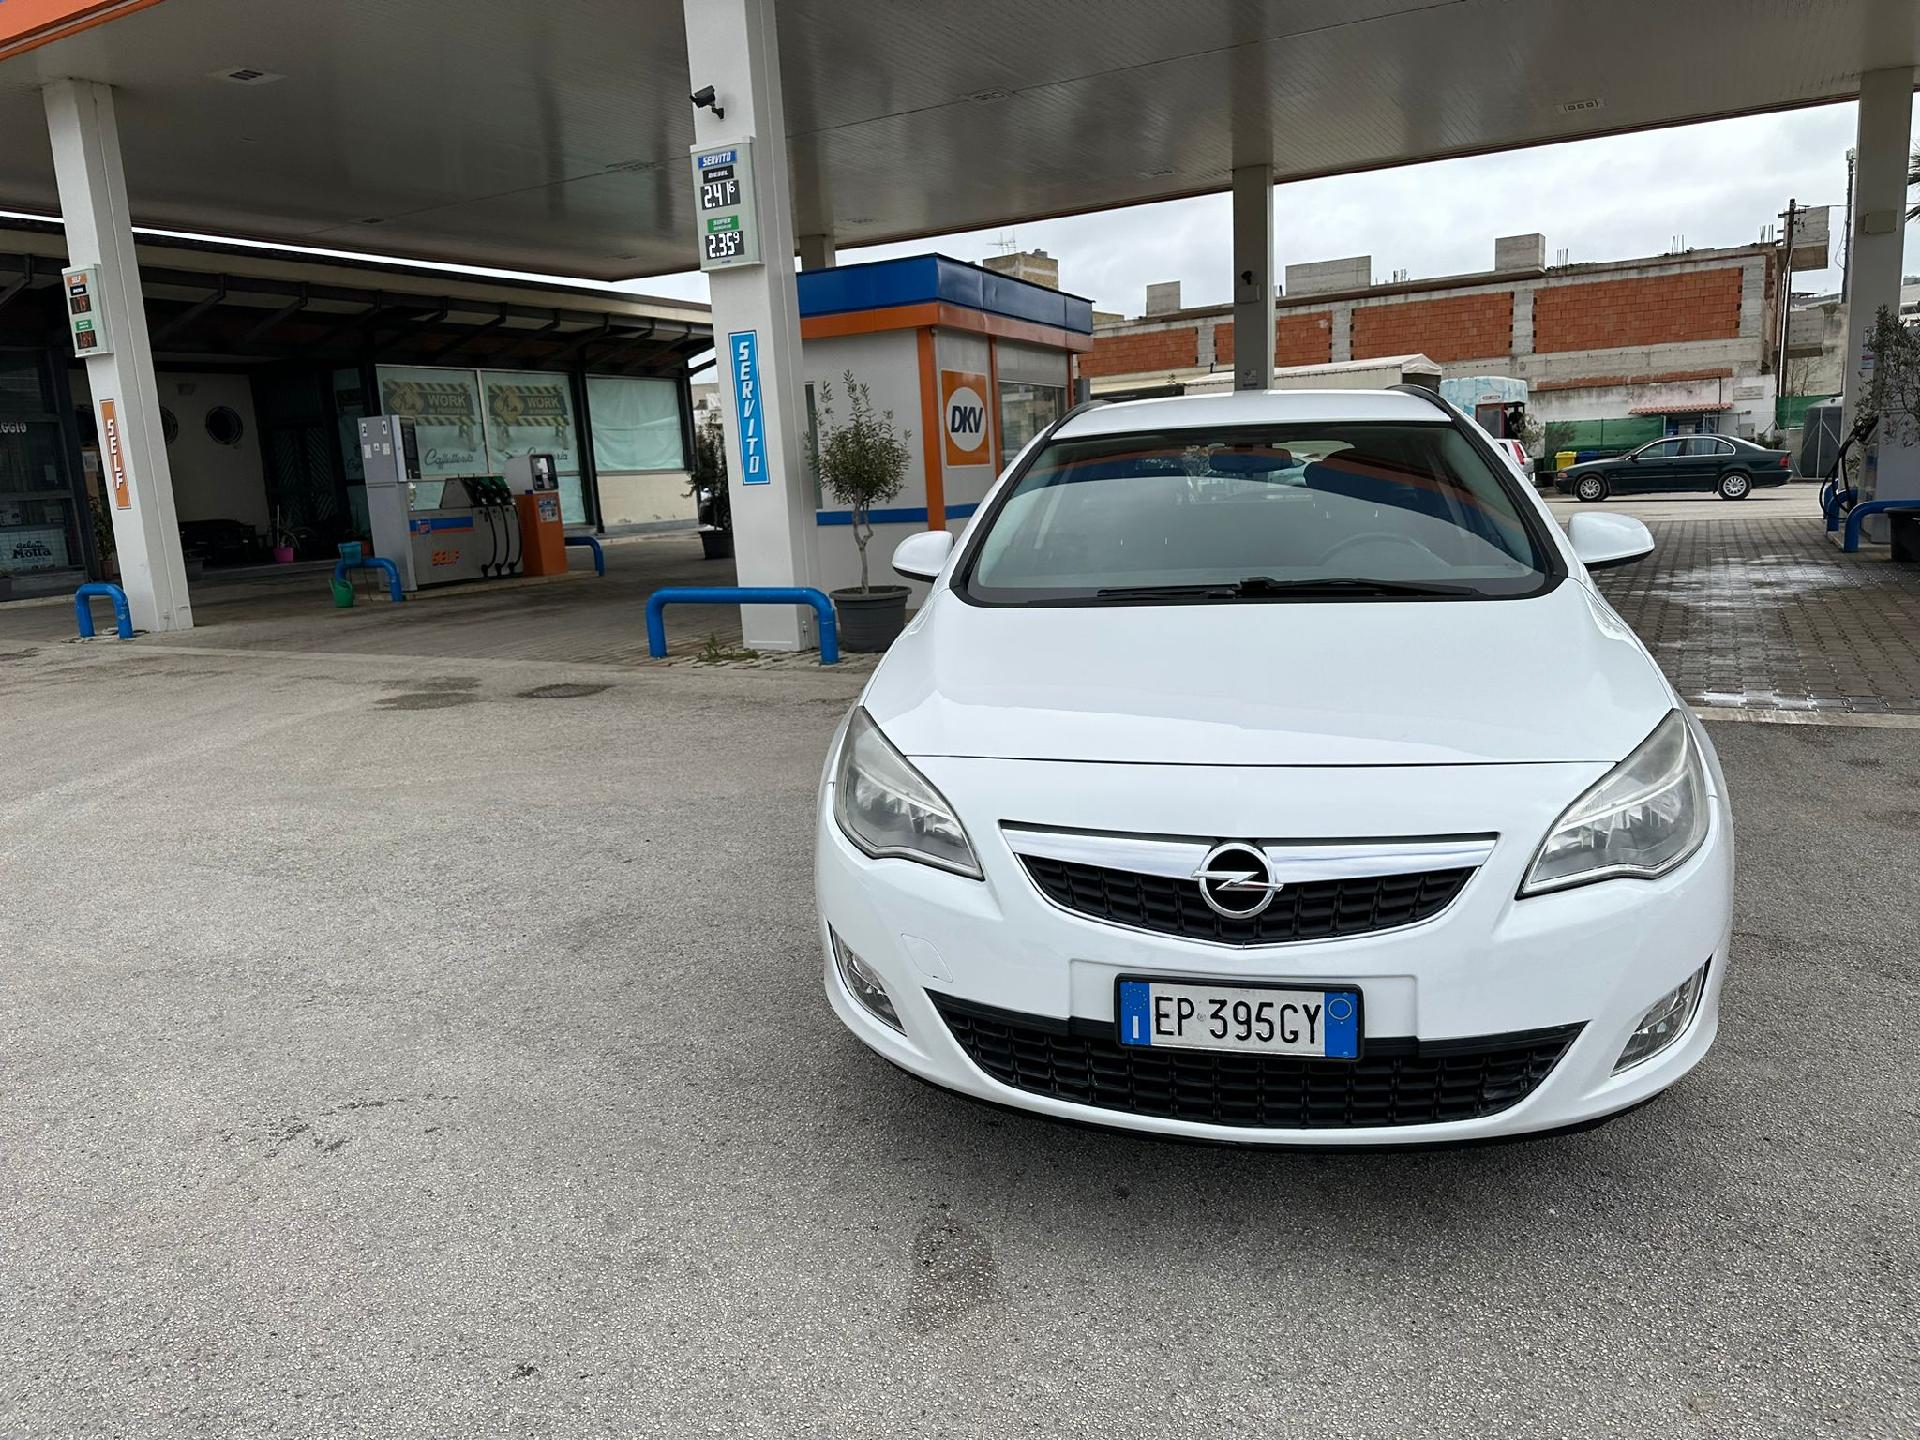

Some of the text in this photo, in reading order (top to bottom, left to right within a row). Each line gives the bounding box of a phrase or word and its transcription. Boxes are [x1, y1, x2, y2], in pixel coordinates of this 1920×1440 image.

[703, 152, 731, 167] SERVITO
[427, 393, 466, 408] WORK
[527, 397, 560, 408] WORK
[738, 341, 760, 474] SERVITO
[951, 405, 983, 433] DKV
[0, 422, 27, 434] GGIO
[107, 418, 123, 489] SELF
[12, 547, 52, 559] Motta
[432, 549, 460, 566] SELF
[1155, 997, 1195, 1036] EP
[1208, 999, 1321, 1044] 395GY
